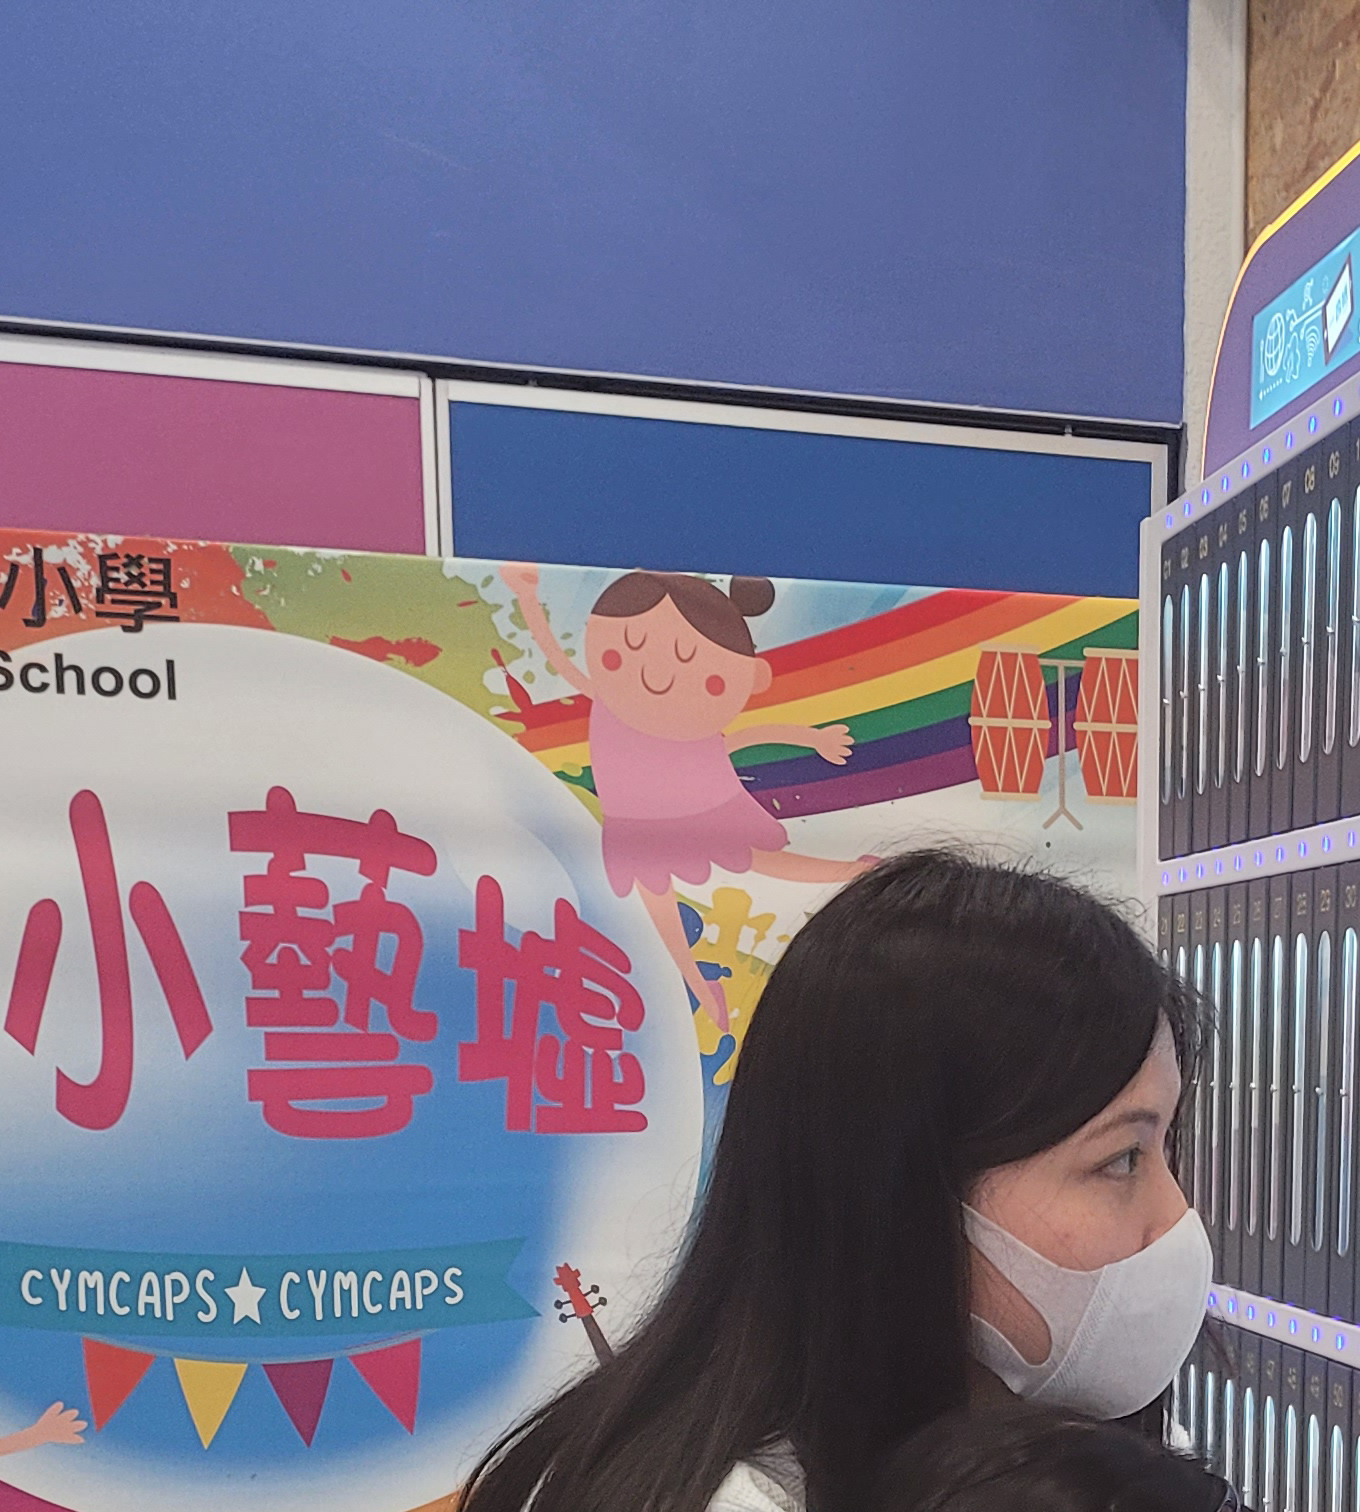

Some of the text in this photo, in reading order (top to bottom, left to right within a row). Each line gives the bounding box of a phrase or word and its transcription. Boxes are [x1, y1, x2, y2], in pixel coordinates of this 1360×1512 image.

[1304, 464, 1315, 494] 08
[1328, 450, 1340, 479] 09
[1282, 480, 1292, 508] 07
[0, 546, 180, 634] 小學
[1346, 884, 1356, 908] 30
[3, 785, 648, 1139] 小藝墟
[20, 1266, 464, 1323] CYMCAPS CYMCAPS
